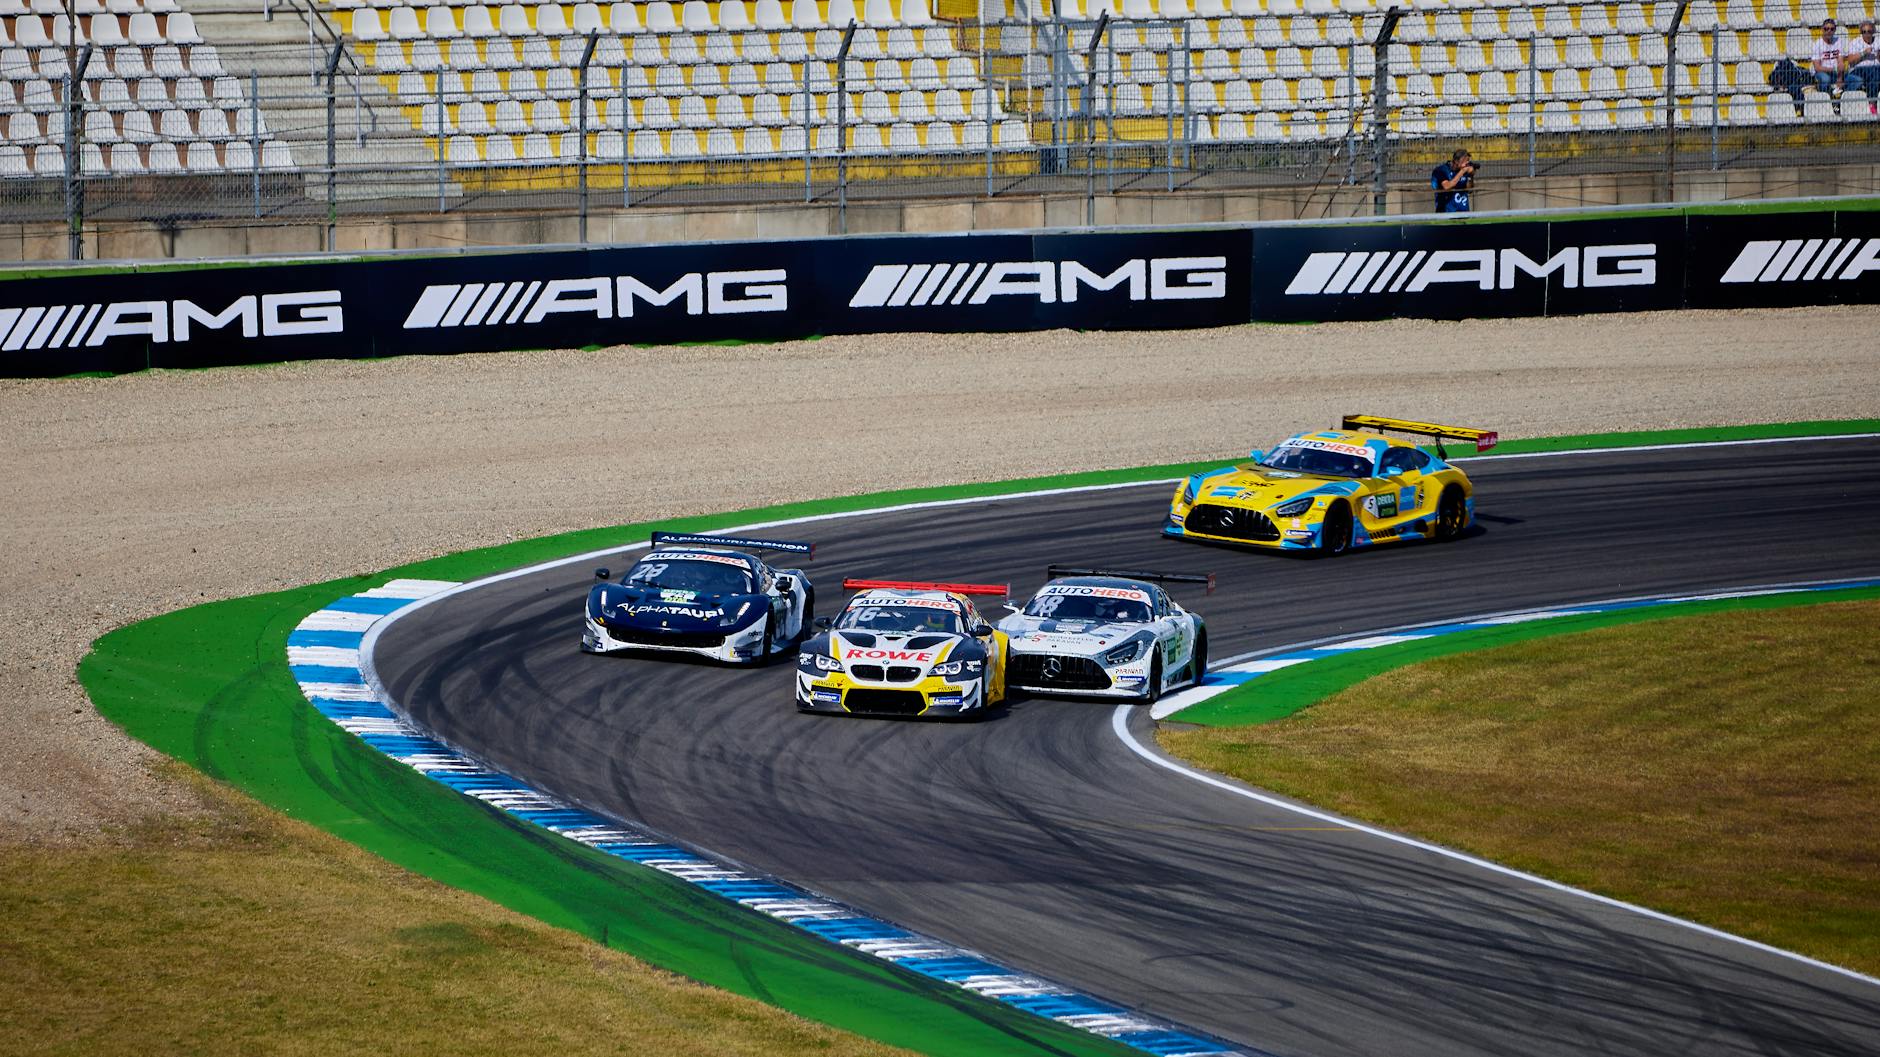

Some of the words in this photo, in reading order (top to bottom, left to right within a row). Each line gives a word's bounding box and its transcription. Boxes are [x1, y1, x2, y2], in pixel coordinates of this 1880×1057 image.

[1404, 243, 1657, 292] AMG
[968, 256, 1227, 304] AMG
[523, 269, 788, 323] AMG
[85, 290, 344, 347] AMG
[1288, 440, 1369, 456] AUTOHERO
[1046, 587, 1142, 599] AUTOHERO
[617, 602, 725, 618] ALPHATAURI
[860, 599, 955, 609] AUTOHERO
[846, 649, 933, 661] ROWE
